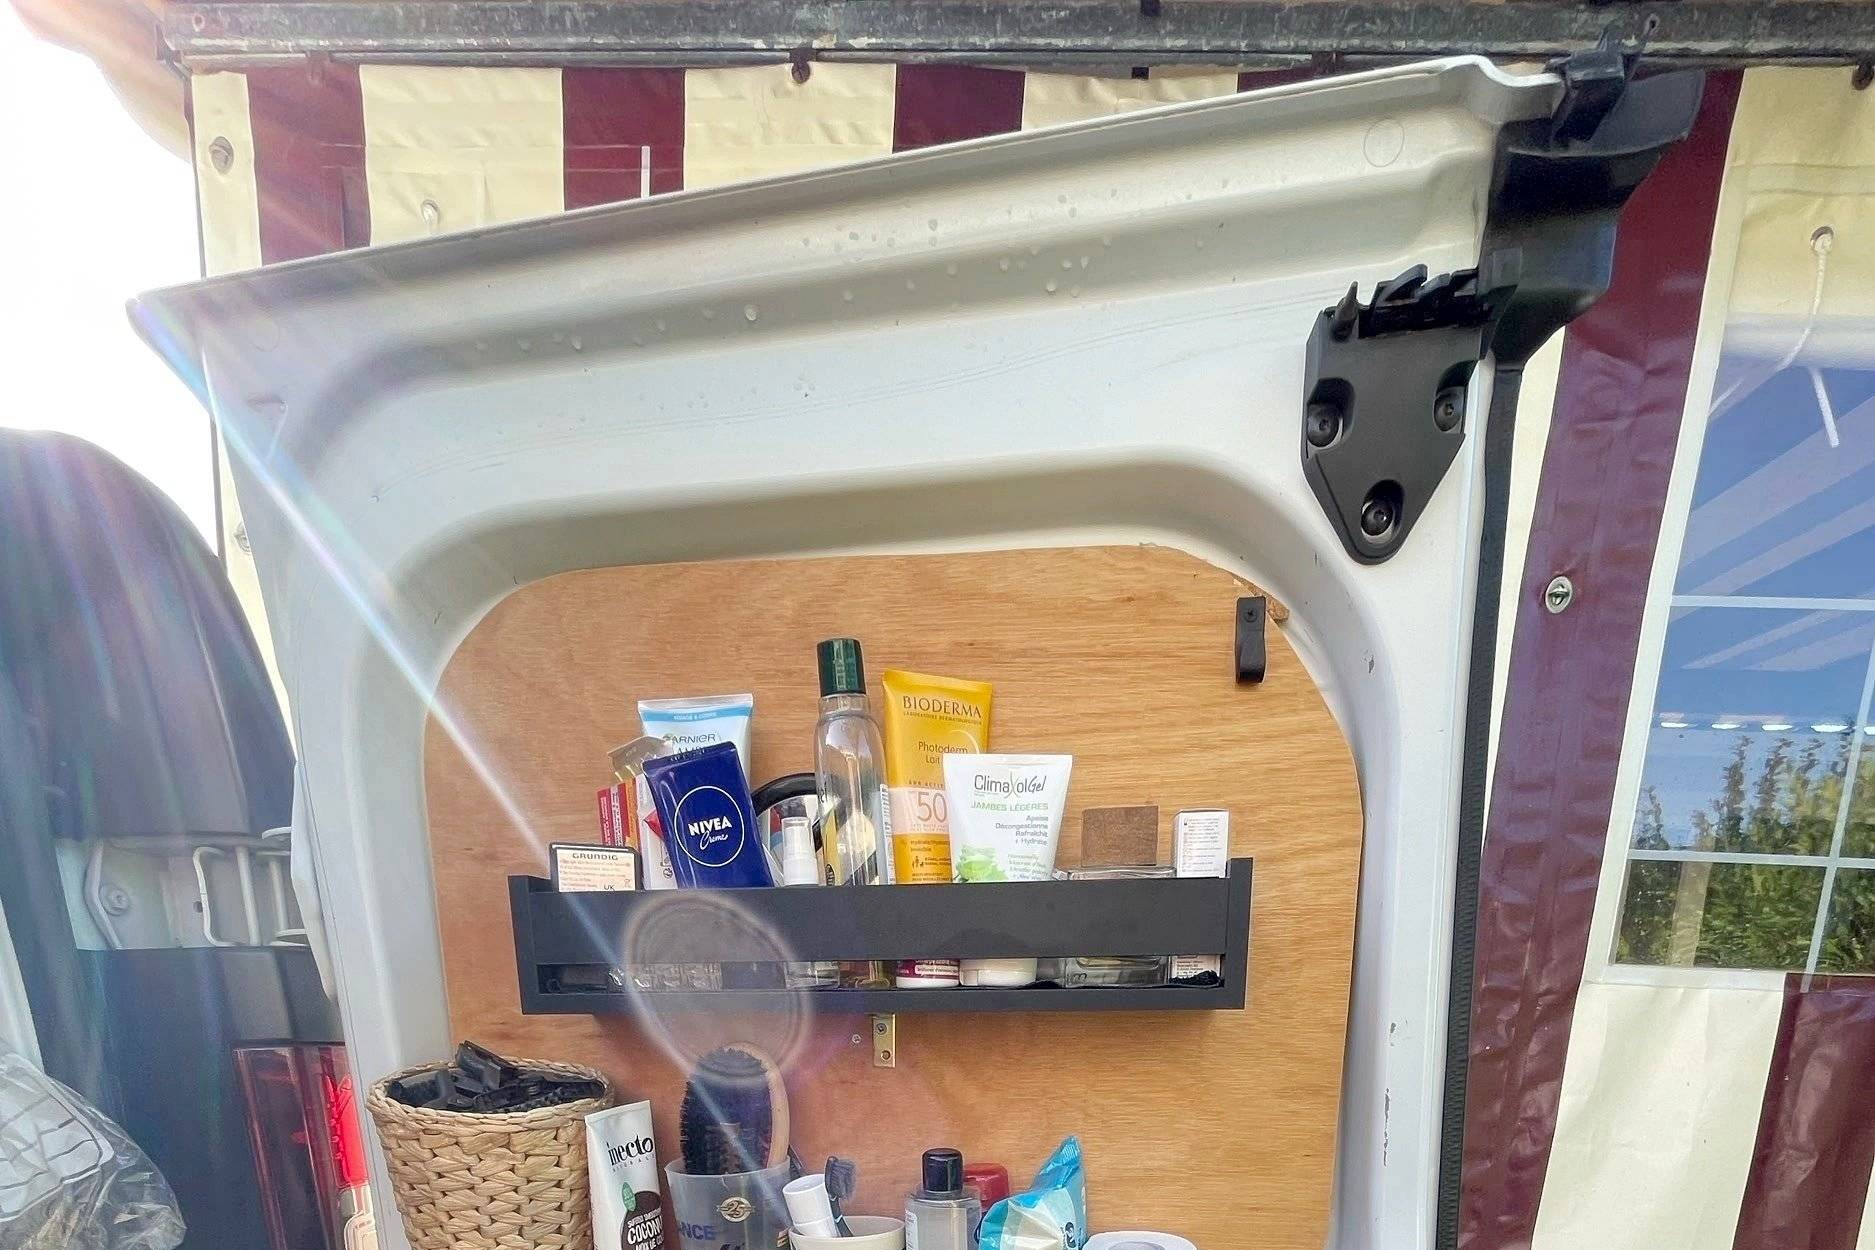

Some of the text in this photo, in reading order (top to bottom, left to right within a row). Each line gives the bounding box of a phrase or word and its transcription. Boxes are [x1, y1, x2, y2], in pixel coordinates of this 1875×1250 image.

[903, 695, 982, 718] BIODERMA
[918, 741, 968, 755] Photoderm
[926, 755, 940, 764] Lait
[916, 791, 948, 823] 50
[970, 801, 1008, 812] JAMBES
[688, 815, 733, 836] NIVEA
[572, 852, 619, 861] GRUNDIG
[606, 1135, 654, 1166] inecto
